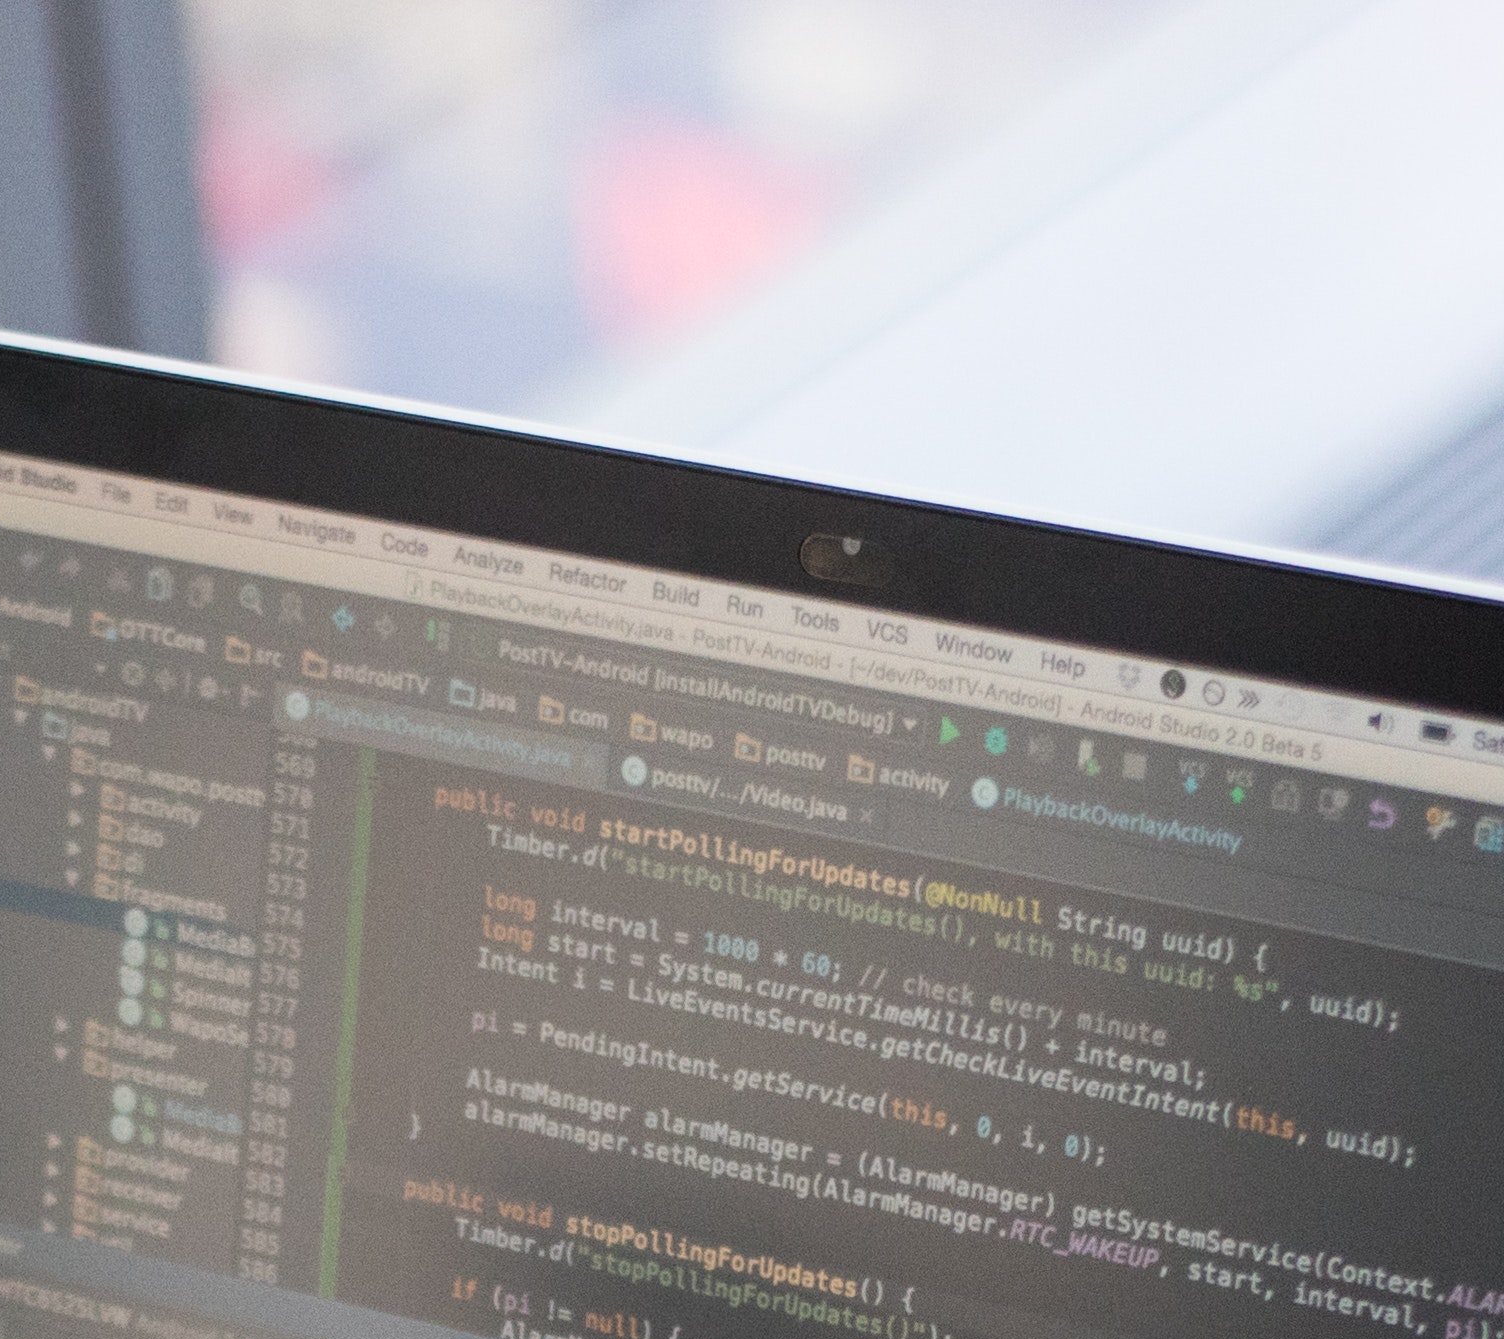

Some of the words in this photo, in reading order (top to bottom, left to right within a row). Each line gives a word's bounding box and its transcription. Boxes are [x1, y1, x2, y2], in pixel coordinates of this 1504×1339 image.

[19, 467, 79, 496] Studio
[99, 481, 132, 506] File
[153, 491, 189, 516] Edit
[212, 502, 255, 528] View
[276, 513, 356, 547] Navigate
[379, 532, 429, 560] Code
[452, 545, 525, 578] Analyze
[548, 562, 628, 596] Refactor
[650, 581, 702, 609] Build
[725, 594, 764, 620] Run
[791, 606, 841, 634] Tools
[865, 619, 910, 647] VCS
[934, 632, 1013, 665] Window
[1039, 651, 1086, 683] Help
[254, 647, 283, 668] src
[331, 662, 430, 697] androidTV
[428, 579, 675, 643] PlaybackOverlayActivity.java
[691, 627, 832, 672] PostTV-Android
[1079, 698, 1154, 731] Android
[1158, 713, 1220, 743] Studio
[1223, 725, 1257, 750] 2.0
[1259, 731, 1304, 759] Beta
[1309, 740, 1325, 762] 5
[476, 685, 517, 714] java
[497, 638, 650, 686] PostTV-Android
[652, 667, 896, 736] [installAndroidTVDebug]
[568, 708, 609, 731] com
[660, 725, 714, 753] wapo
[765, 745, 827, 773] posttv
[878, 765, 950, 801] activity
[434, 788, 517, 820] public
[529, 807, 586, 834] void
[598, 818, 1043, 925] startPollingForUpdates(@NonNull
[1055, 906, 1146, 951] String
[1159, 932, 1237, 969] uuid)
[1002, 785, 1243, 857] PlaybackOverlayActivity
[481, 886, 537, 923] long
[549, 900, 661, 943] interval
[701, 931, 759, 964] 1000
[800, 951, 844, 987] 60;
[900, 974, 974, 1008] check
[987, 994, 1062, 1032] every
[1075, 1010, 1166, 1047] minute
[486, 825, 980, 950] Timber.d("startPollingForUpdates(),
[993, 929, 1054, 960] with
[1067, 941, 1128, 974] this
[1141, 961, 1218, 993] uuid:
[1231, 974, 1294, 1014] %s",
[1307, 994, 1401, 1035] uuid);
[476, 947, 559, 985] Intent
[626, 978, 1310, 1148] LiveEventsService.getCheckLiveEventIntent(this,
[1324, 1129, 1418, 1171] uuid);
[479, 916, 534, 954] long
[547, 933, 617, 966] start
[657, 953, 1030, 1057] System.currentTimeMillis()
[1072, 1039, 1208, 1094] interval;
[539, 1022, 962, 1139] PendingIntent.getService(this,
[467, 1068, 631, 1124] AlarmManager
[644, 1109, 813, 1164] alarmManager
[853, 1152, 1058, 1223] (AlarmManager)
[404, 1180, 485, 1214] public
[497, 1202, 553, 1230] void
[565, 1215, 887, 1311] stopPollingForUpdates()
[464, 1101, 1172, 1281] alarmManager.setRepeating(AlarmManager.RTC_WAKEUP,
[1186, 1260, 1277, 1304] start,
[1291, 1280, 1430, 1338] interval,
